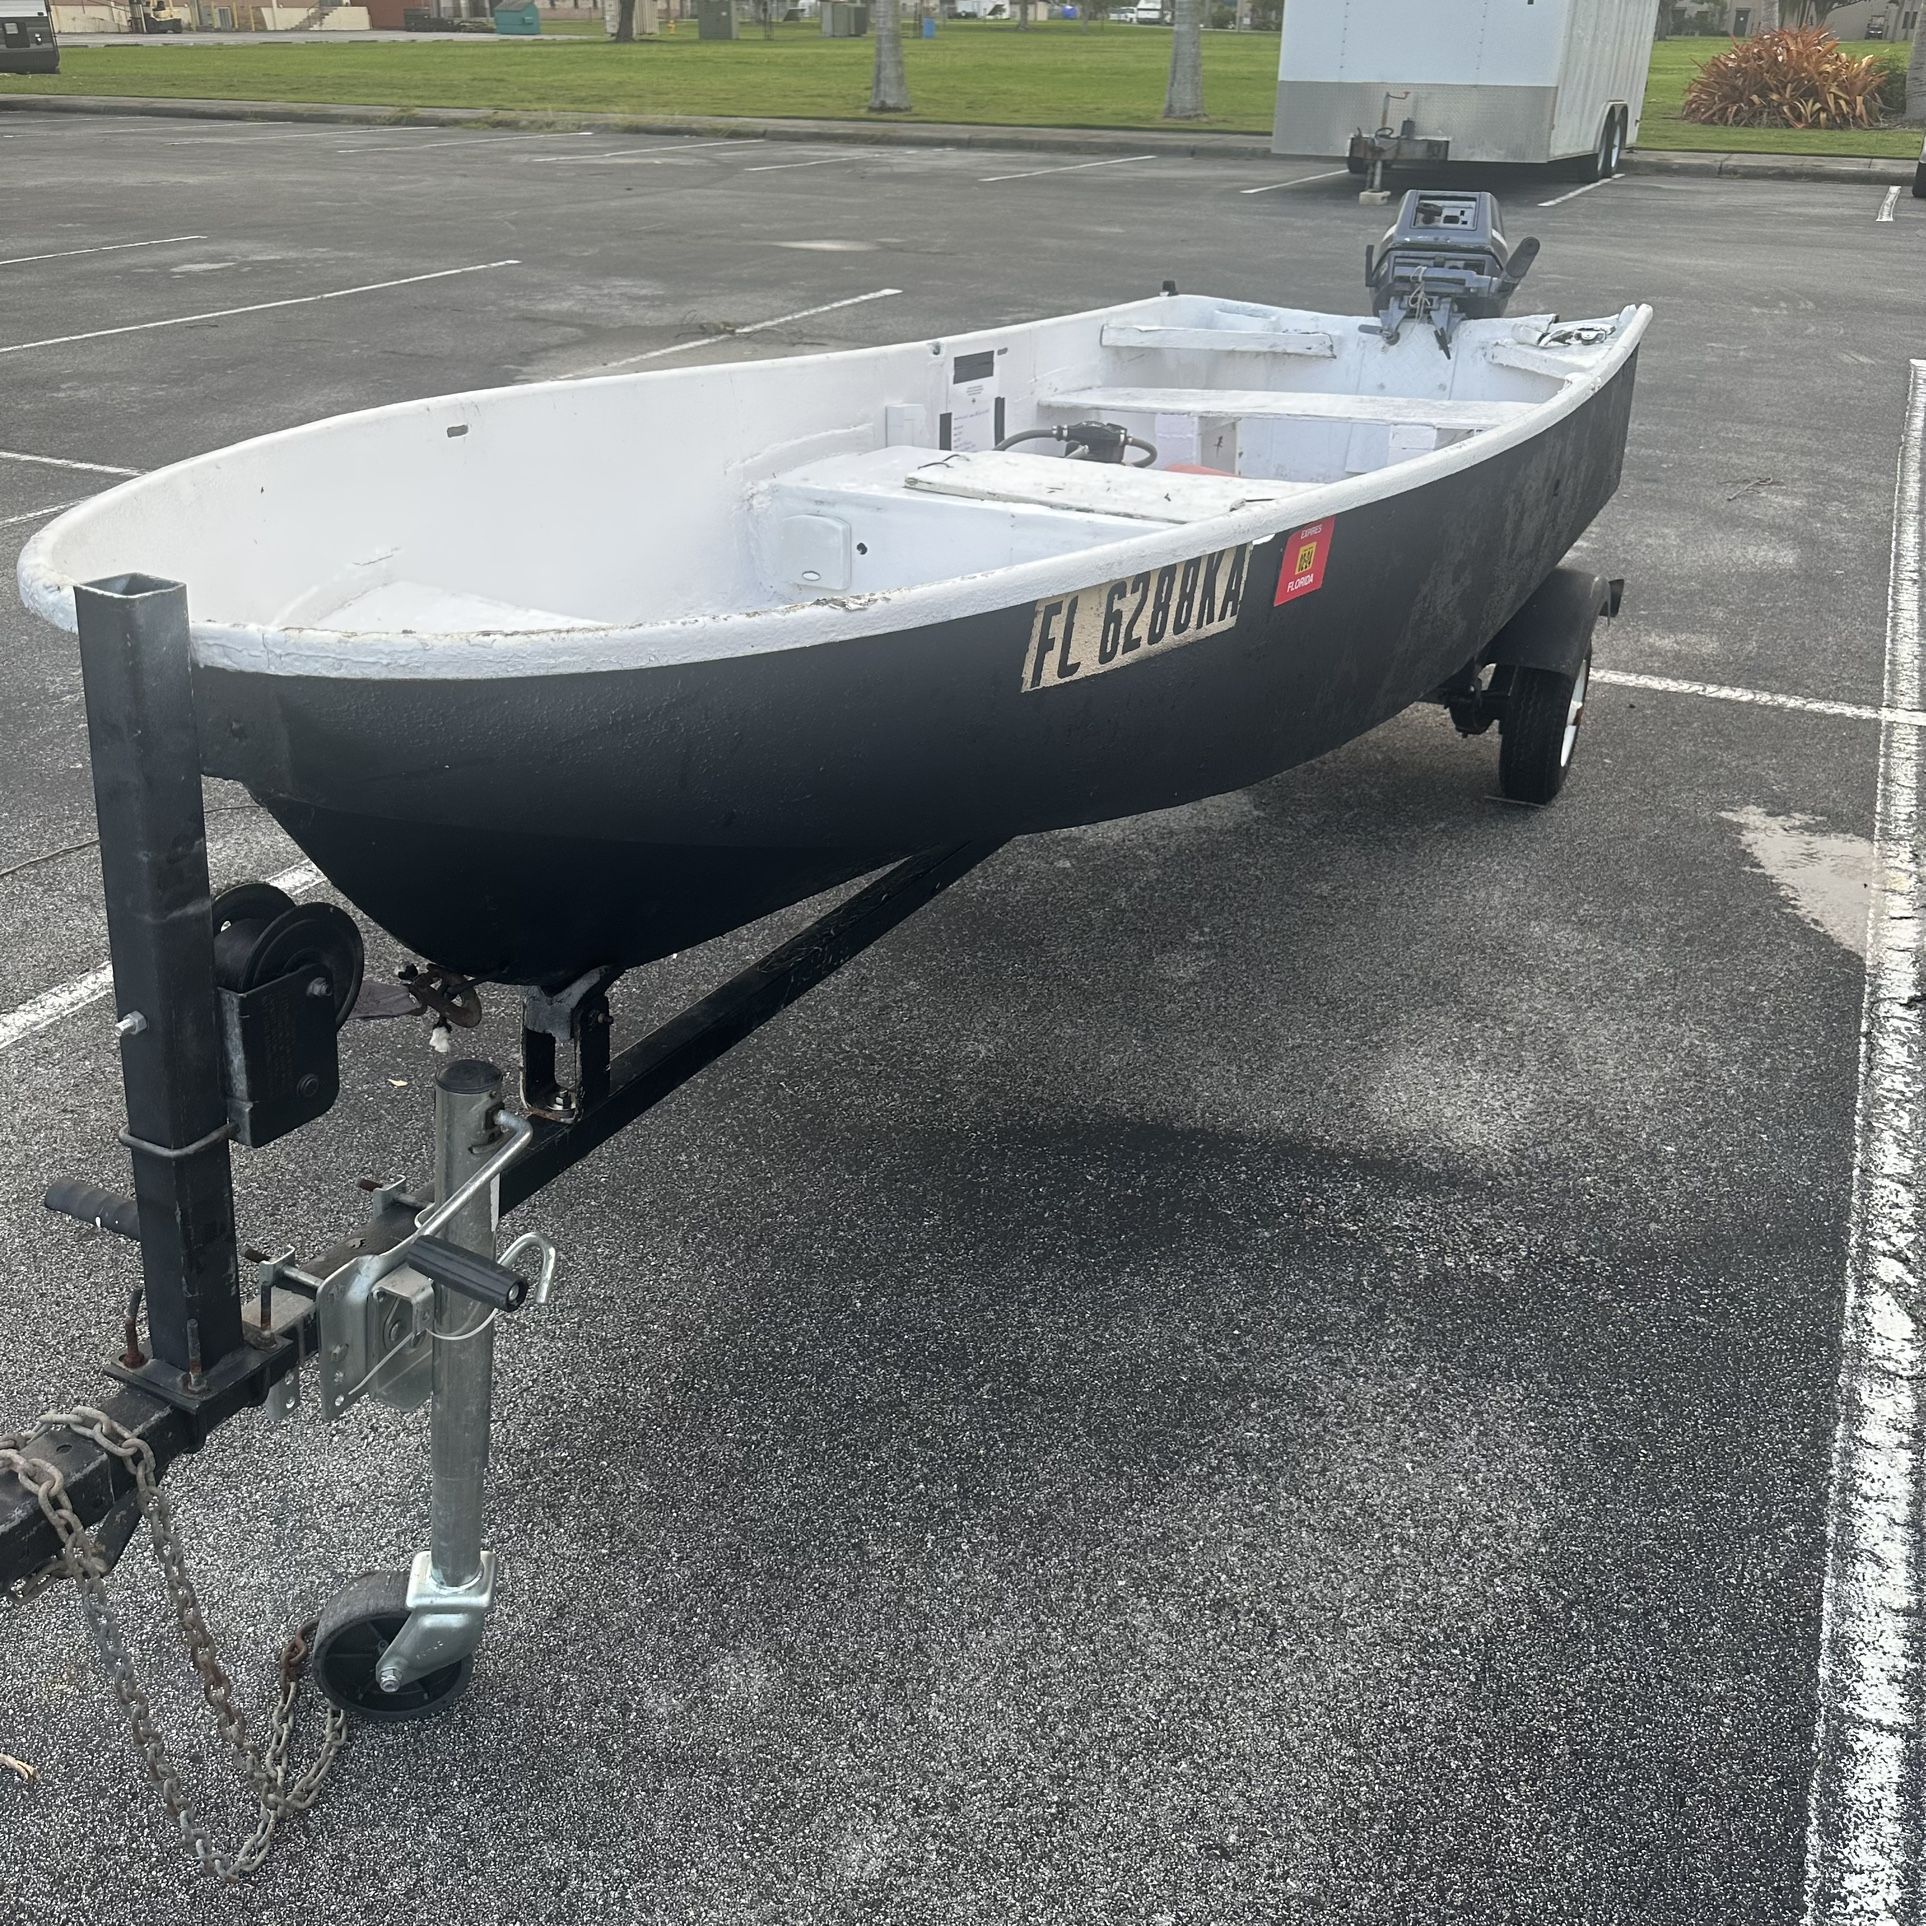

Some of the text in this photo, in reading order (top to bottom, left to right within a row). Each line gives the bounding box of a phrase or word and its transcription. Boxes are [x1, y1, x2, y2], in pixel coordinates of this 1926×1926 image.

[1030, 543, 1250, 689] FL 6288KA
[1286, 573, 1314, 593] FLORIDA
